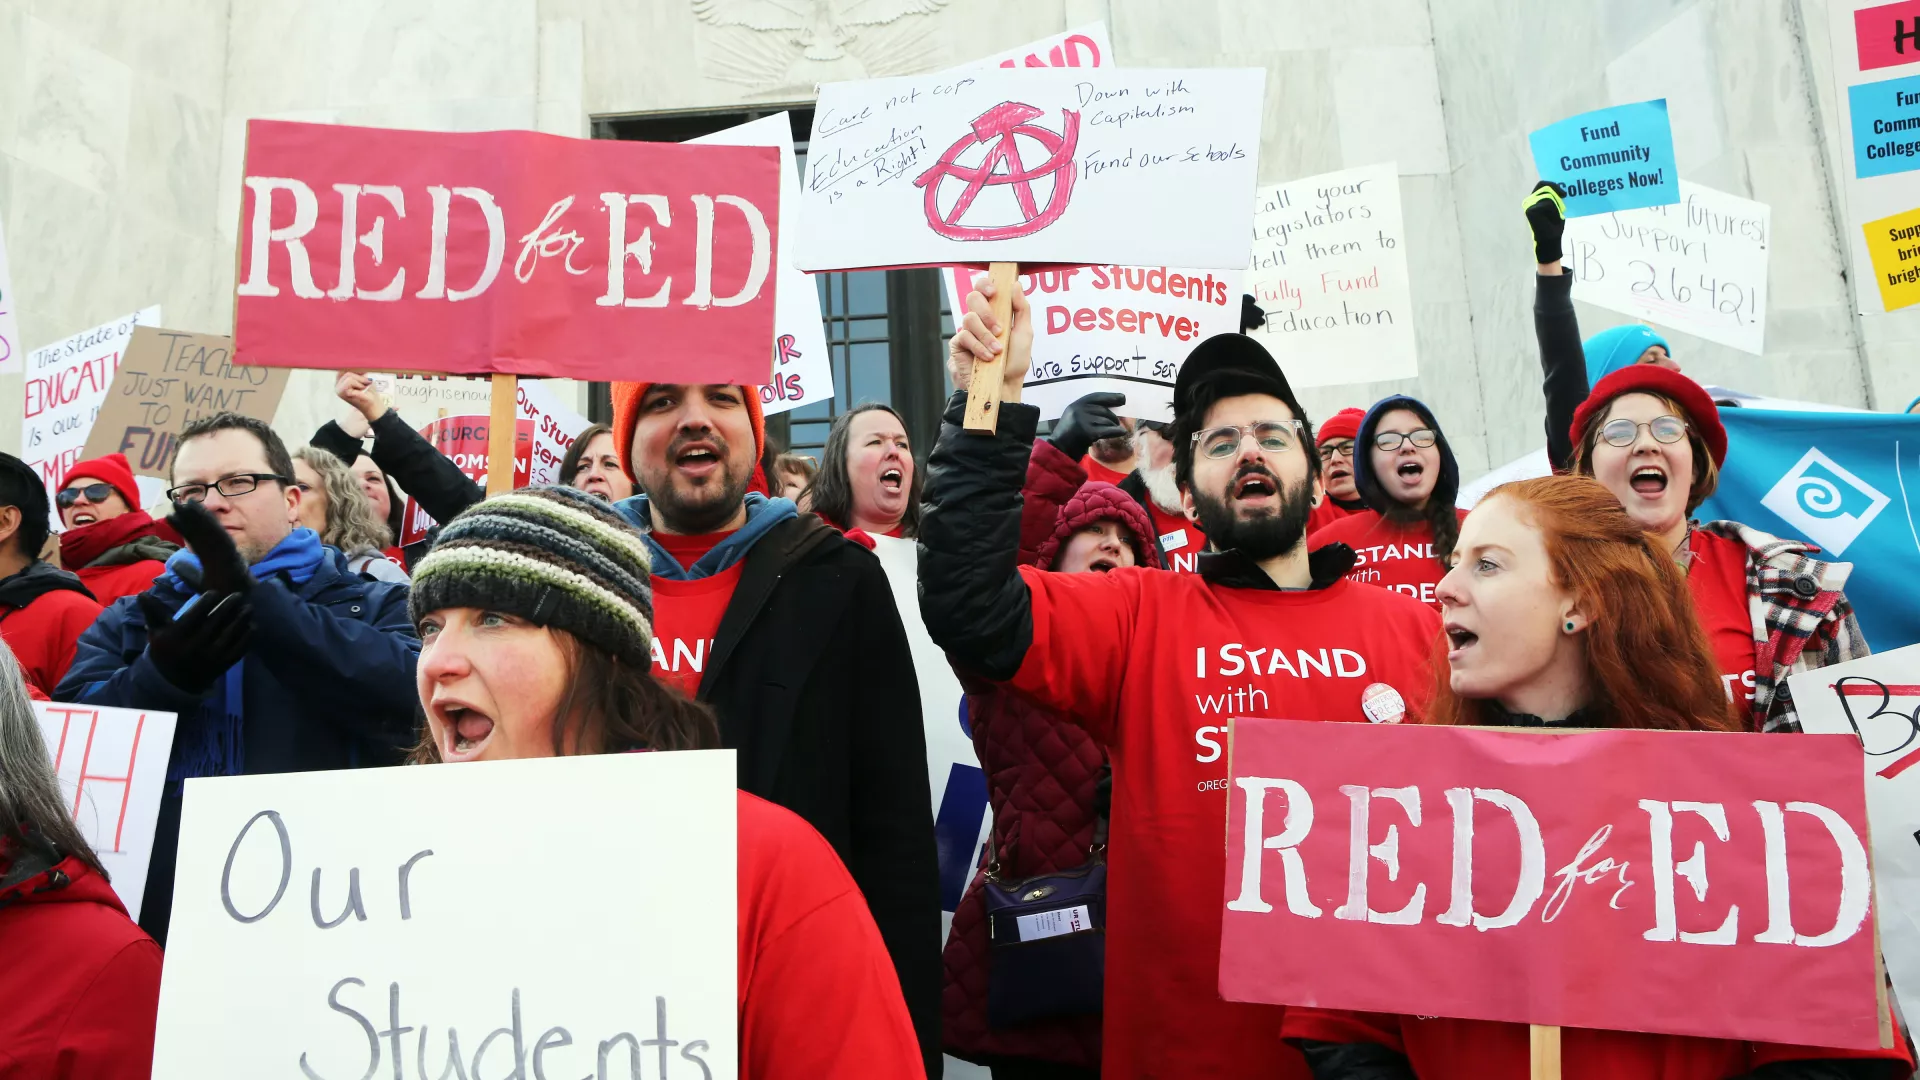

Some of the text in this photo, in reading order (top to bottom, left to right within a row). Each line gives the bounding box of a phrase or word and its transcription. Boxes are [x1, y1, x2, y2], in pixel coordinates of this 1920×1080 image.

[818, 78, 975, 133] Care not cops
[1075, 80, 1191, 108] Down with
[1580, 120, 1621, 143] Fund
[809, 125, 922, 192] Education
[829, 137, 927, 204] is a Right!
[1084, 147, 1133, 180] Fund
[1139, 152, 1178, 168] our
[1560, 145, 1651, 172] Community
[1627, 167, 1664, 188] Now!
[1316, 179, 1373, 210] your
[236, 175, 772, 309] RED for ED
[1253, 204, 1372, 247] Legislators
[1251, 230, 1396, 271] tell them to
[1091, 264, 1228, 307] Students
[1254, 266, 1379, 311] Fully Fund
[1628, 260, 1756, 326] 2642!
[1045, 305, 1200, 342] Deserve:
[1264, 300, 1393, 334] Education
[35, 311, 141, 369] The State of
[123, 371, 256, 411] JUST WANT
[52, 414, 83, 436] our
[140, 402, 171, 426] TO
[651, 636, 715, 673] AN
[1196, 642, 1367, 679] I STAND
[1195, 683, 1269, 715] with
[220, 809, 434, 930] Our
[1226, 775, 1872, 948] RED for ED
[300, 976, 713, 1080] Students
